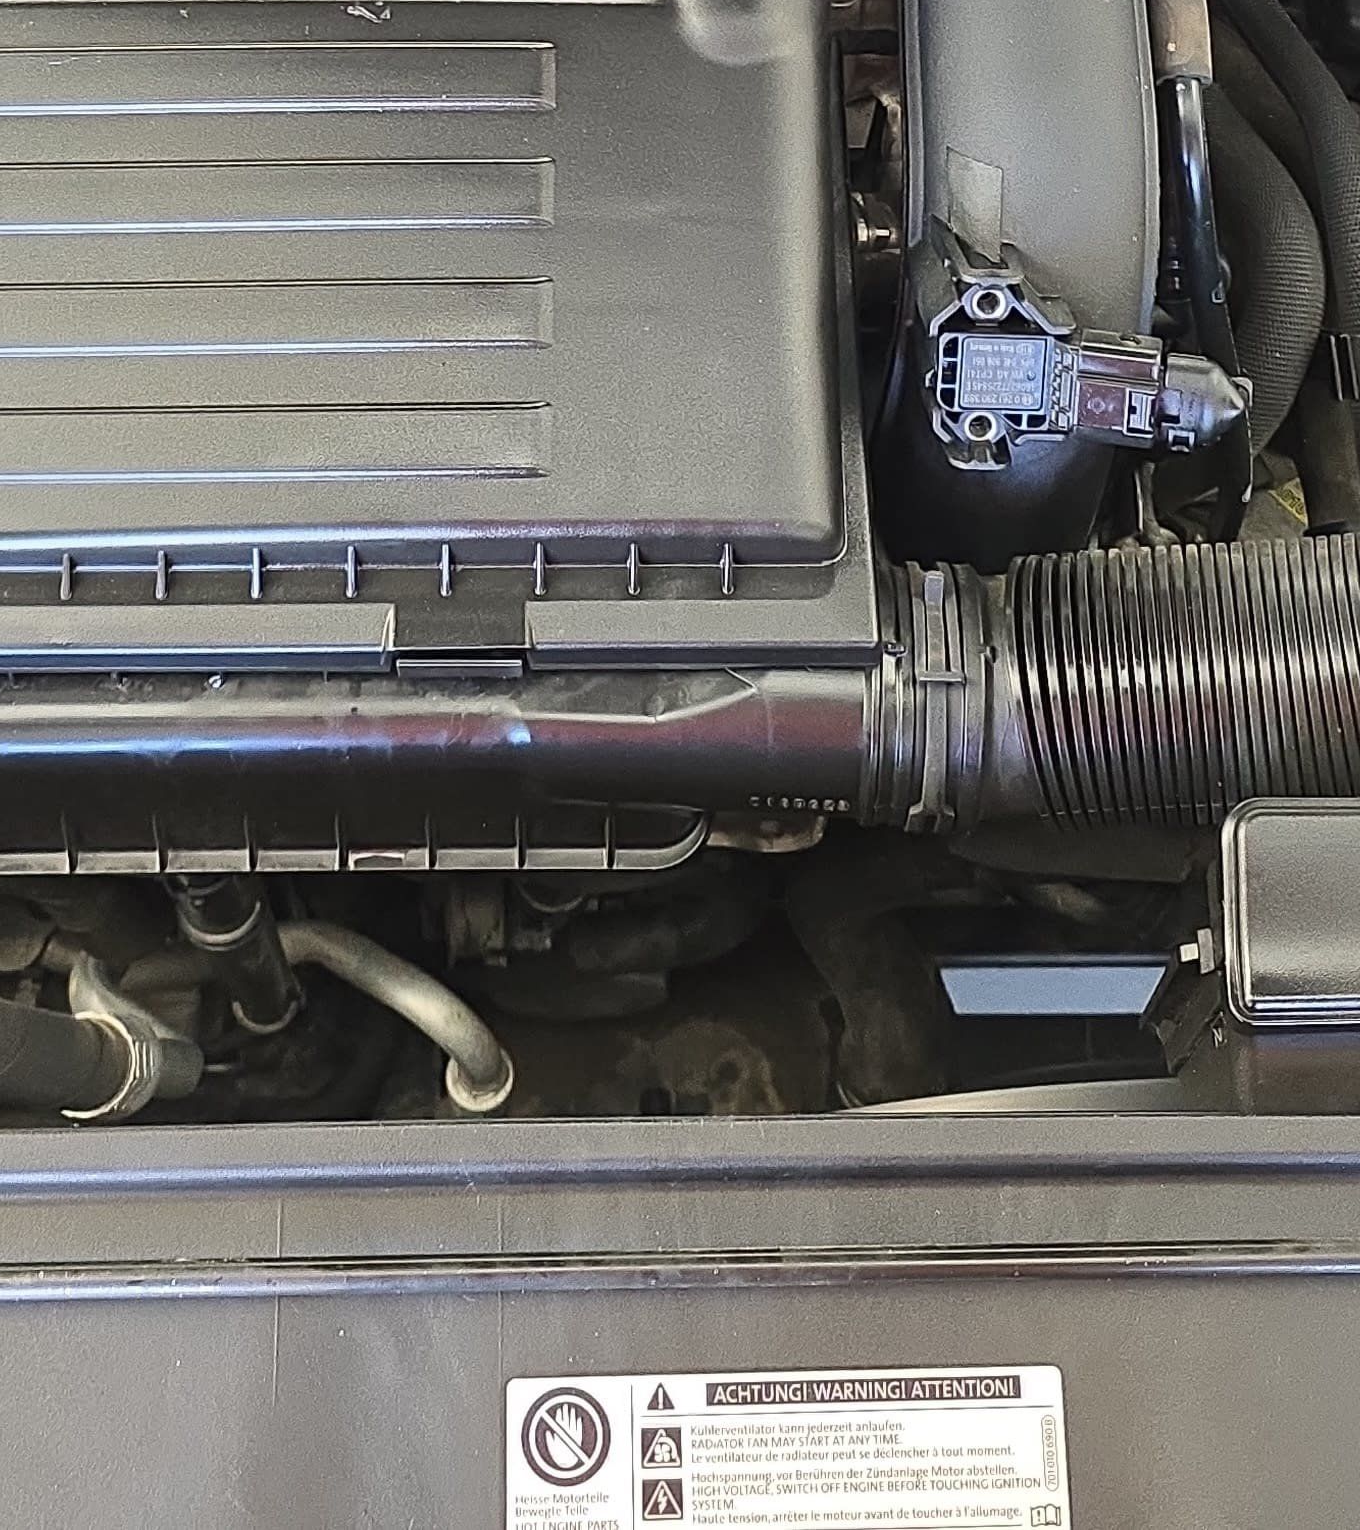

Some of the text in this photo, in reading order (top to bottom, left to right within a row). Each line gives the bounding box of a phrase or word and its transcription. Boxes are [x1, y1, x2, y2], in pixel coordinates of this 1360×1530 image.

[779, 1423, 804, 1434] kann
[807, 1421, 852, 1436] jederzeit
[692, 1437, 743, 1449] RADIATOR
[747, 1437, 768, 1448] FAN
[771, 1436, 796, 1447] MAY
[799, 1435, 829, 1447] START
[833, 1435, 846, 1446] AT
[849, 1434, 871, 1446] ANY
[692, 1452, 702, 1463] Le
[705, 1451, 762, 1463] ventilateur
[765, 1450, 778, 1462] de
[781, 1449, 829, 1461] radiateur
[833, 1449, 856, 1462] peut
[859, 1450, 870, 1459] se
[873, 1446, 930, 1459] déclencher
[942, 1446, 964, 1457] tout
[967, 1445, 1015, 1456] moment.
[777, 1471, 792, 1481] vor
[846, 1468, 863, 1479] der
[866, 1466, 928, 1480] Zündanlage
[931, 1465, 965, 1477] Motor
[967, 1465, 1017, 1476] abstellen.
[692, 1485, 720, 1497] HIGH
[776, 1482, 818, 1495] SWITCH
[821, 1481, 840, 1493] OFF
[843, 1480, 885, 1493] ENGINE
[887, 1479, 927, 1492] BEFORE
[930, 1478, 988, 1491] TOUCHING
[991, 1477, 1041, 1490] IGNITION
[553, 1492, 609, 1504] Motorteile
[565, 1504, 589, 1516] Teile
[692, 1512, 725, 1524] Haute
[773, 1510, 808, 1522] arrêter
[811, 1510, 821, 1520] le
[823, 1509, 862, 1520] moteur
[864, 1509, 893, 1519] avant
[896, 1508, 910, 1519] de
[912, 1507, 952, 1519] toucher
[587, 1519, 619, 1530] PARTS
